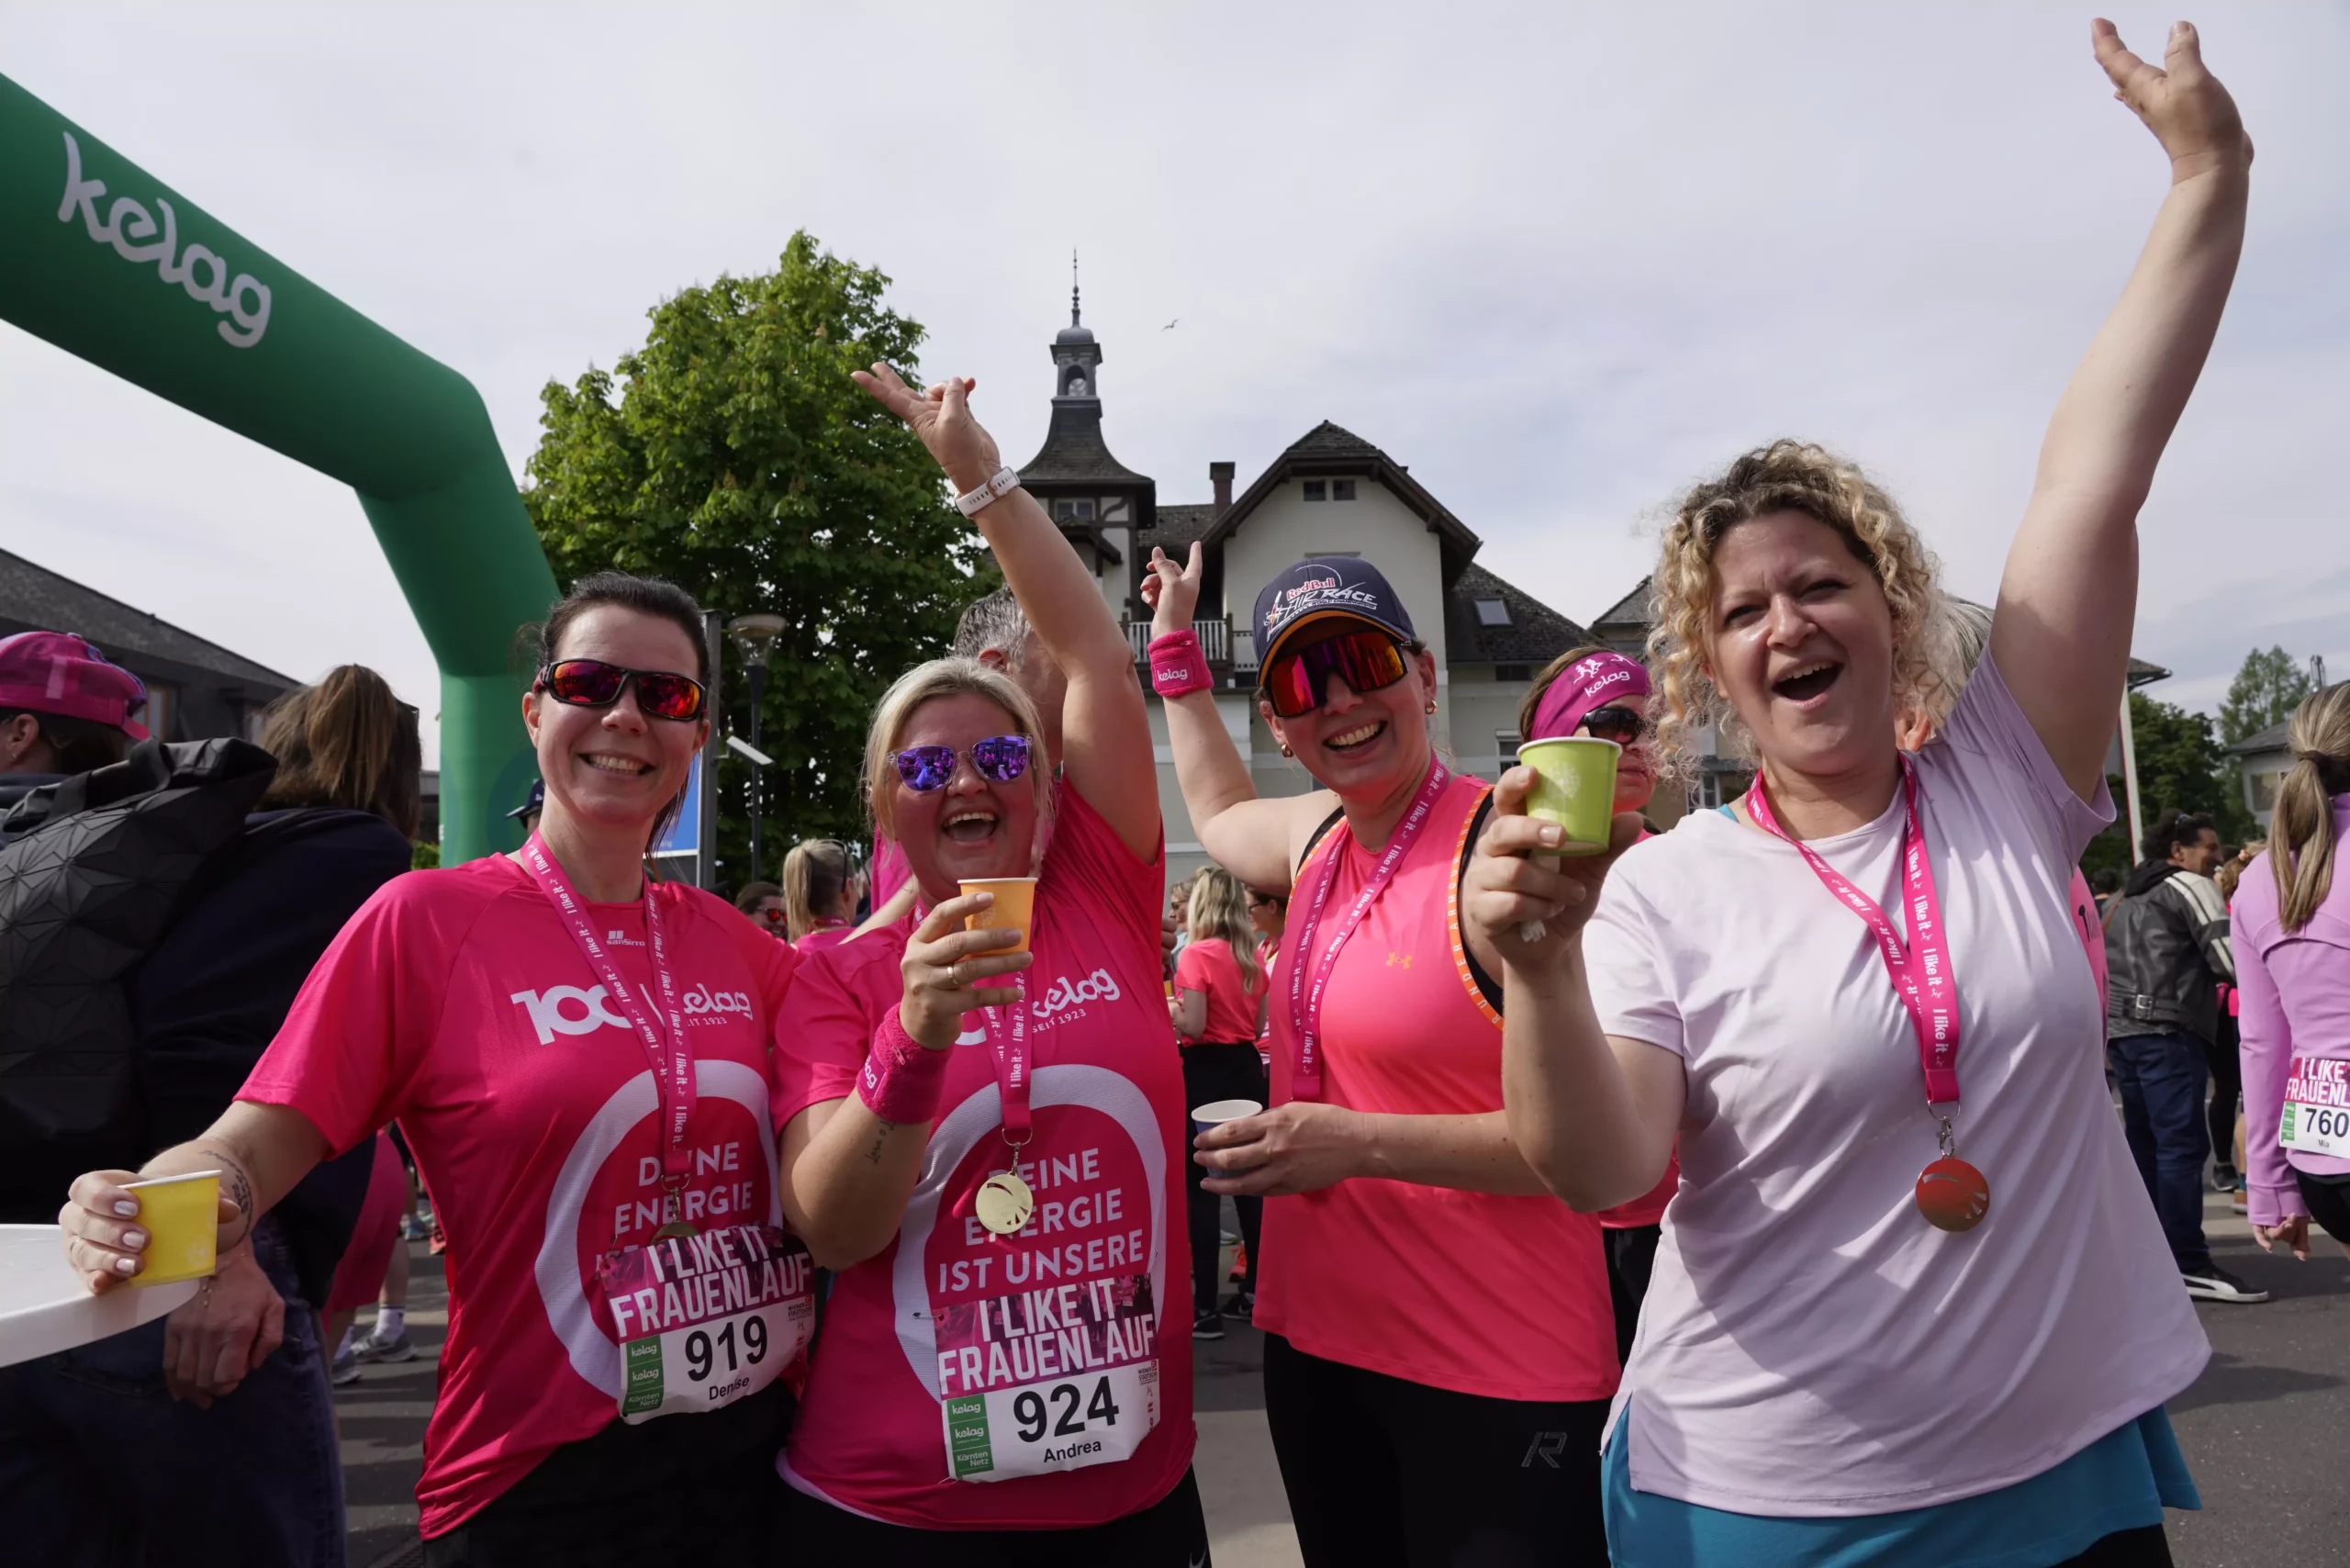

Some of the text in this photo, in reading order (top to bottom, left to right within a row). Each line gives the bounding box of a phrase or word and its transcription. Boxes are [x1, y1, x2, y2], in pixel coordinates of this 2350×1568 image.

[58, 131, 272, 347] kelag
[1286, 577, 1336, 601] Red Bull
[1317, 584, 1378, 605] RACE
[1157, 668, 1188, 682] kelag
[1584, 671, 1630, 698] kelag
[606, 938, 646, 946] sanSirro
[1448, 857, 1488, 1009] UNDER ARMOUR
[683, 983, 753, 1021] elag
[702, 1016, 727, 1025] 1923
[1058, 1008, 1087, 1024] 1923
[2300, 1057, 2347, 1083] I LIKE
[2305, 1107, 2350, 1137] 760
[2318, 1138, 2330, 1148] Mia
[639, 1142, 739, 1186] DNE
[988, 1148, 1101, 1192] EINE
[615, 1182, 753, 1235] ENERGIE
[966, 1188, 1123, 1246] EERGIE
[647, 1245, 665, 1282] I
[668, 1228, 742, 1279] LIKE
[740, 1226, 769, 1261] IT
[939, 1229, 1144, 1293] IST UNSERE
[610, 1252, 811, 1338] FRAUENLAUF
[979, 1278, 1115, 1342] I LIKE IT
[632, 1345, 657, 1357] kelag
[685, 1315, 768, 1383] 919
[937, 1314, 1154, 1395] FRAUENLAUF
[632, 1369, 659, 1382] kelag
[708, 1376, 750, 1402] Denise
[952, 1404, 981, 1415] kelag
[1013, 1375, 1120, 1444] 924
[955, 1427, 984, 1439] kelag
[969, 1458, 990, 1467] Netz
[1044, 1439, 1102, 1463] Andrea
